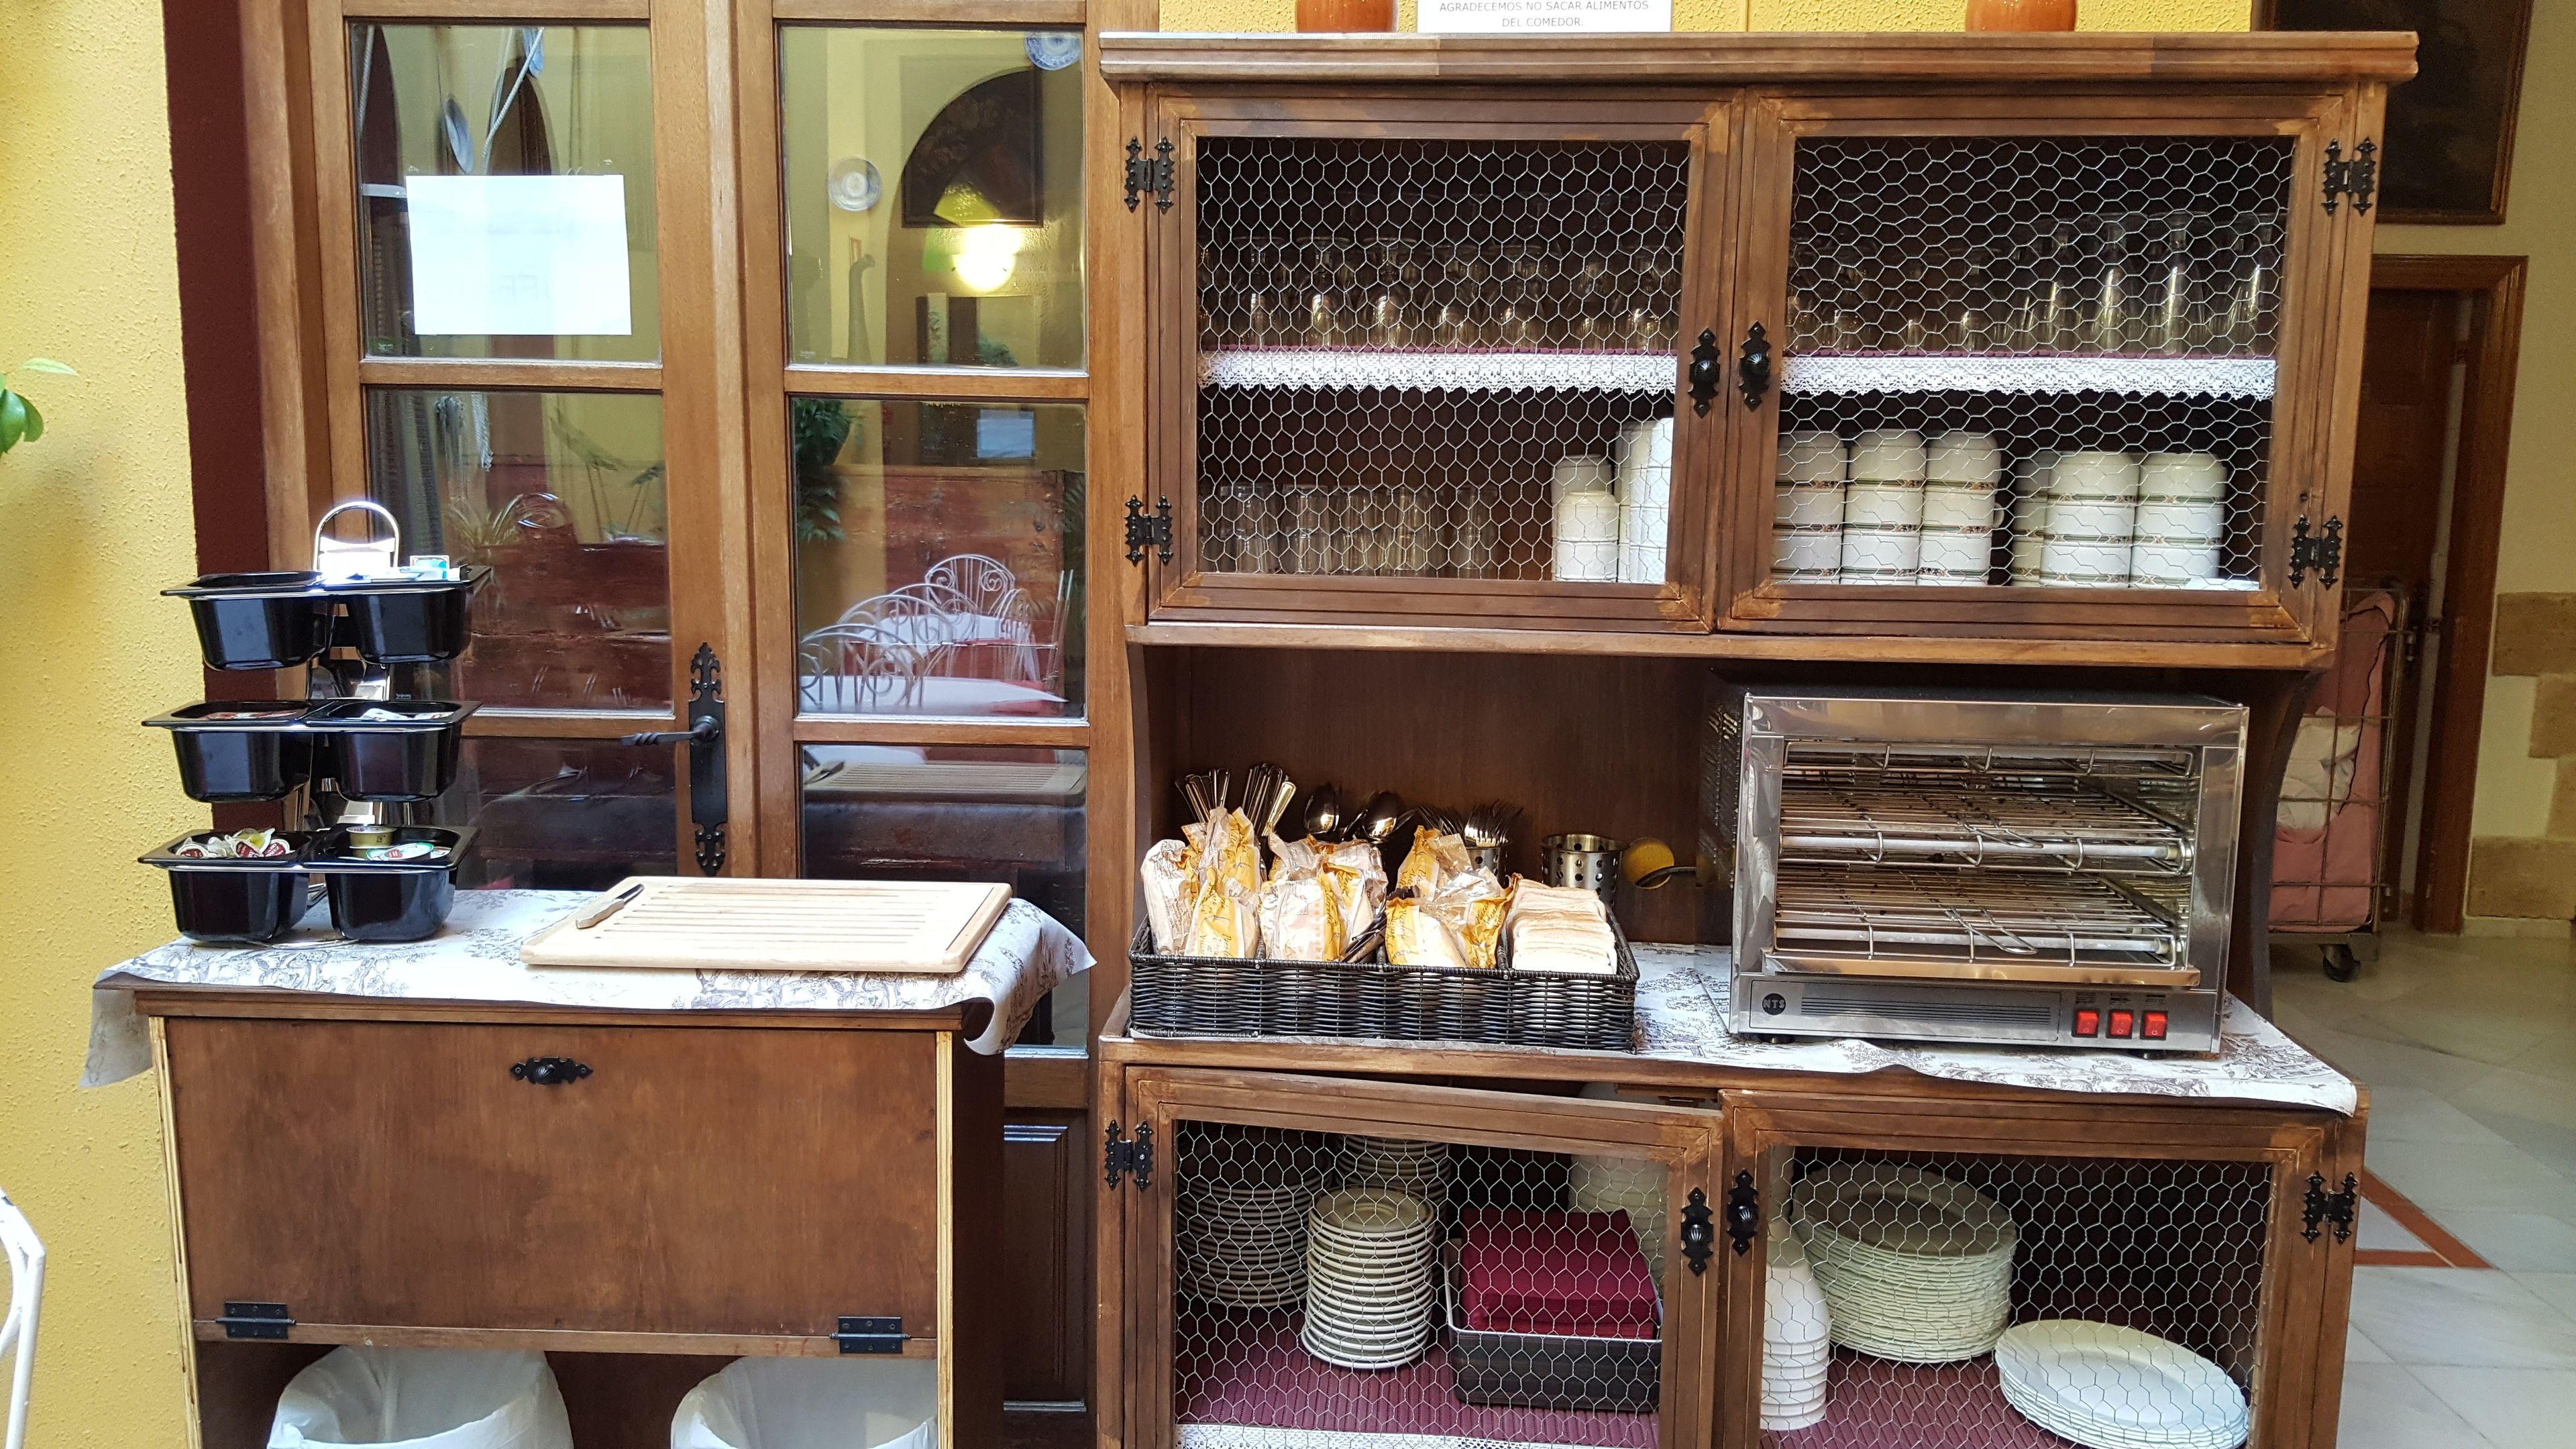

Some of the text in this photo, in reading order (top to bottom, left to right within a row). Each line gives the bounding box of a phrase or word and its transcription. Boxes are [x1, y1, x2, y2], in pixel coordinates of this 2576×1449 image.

[1440, 1, 1648, 11] AGRADECEMOS NO SACAR ALIMENTOS
[1502, 17, 1584, 27] DEL COMEDOR.
[1763, 999, 1785, 1009] NTS
